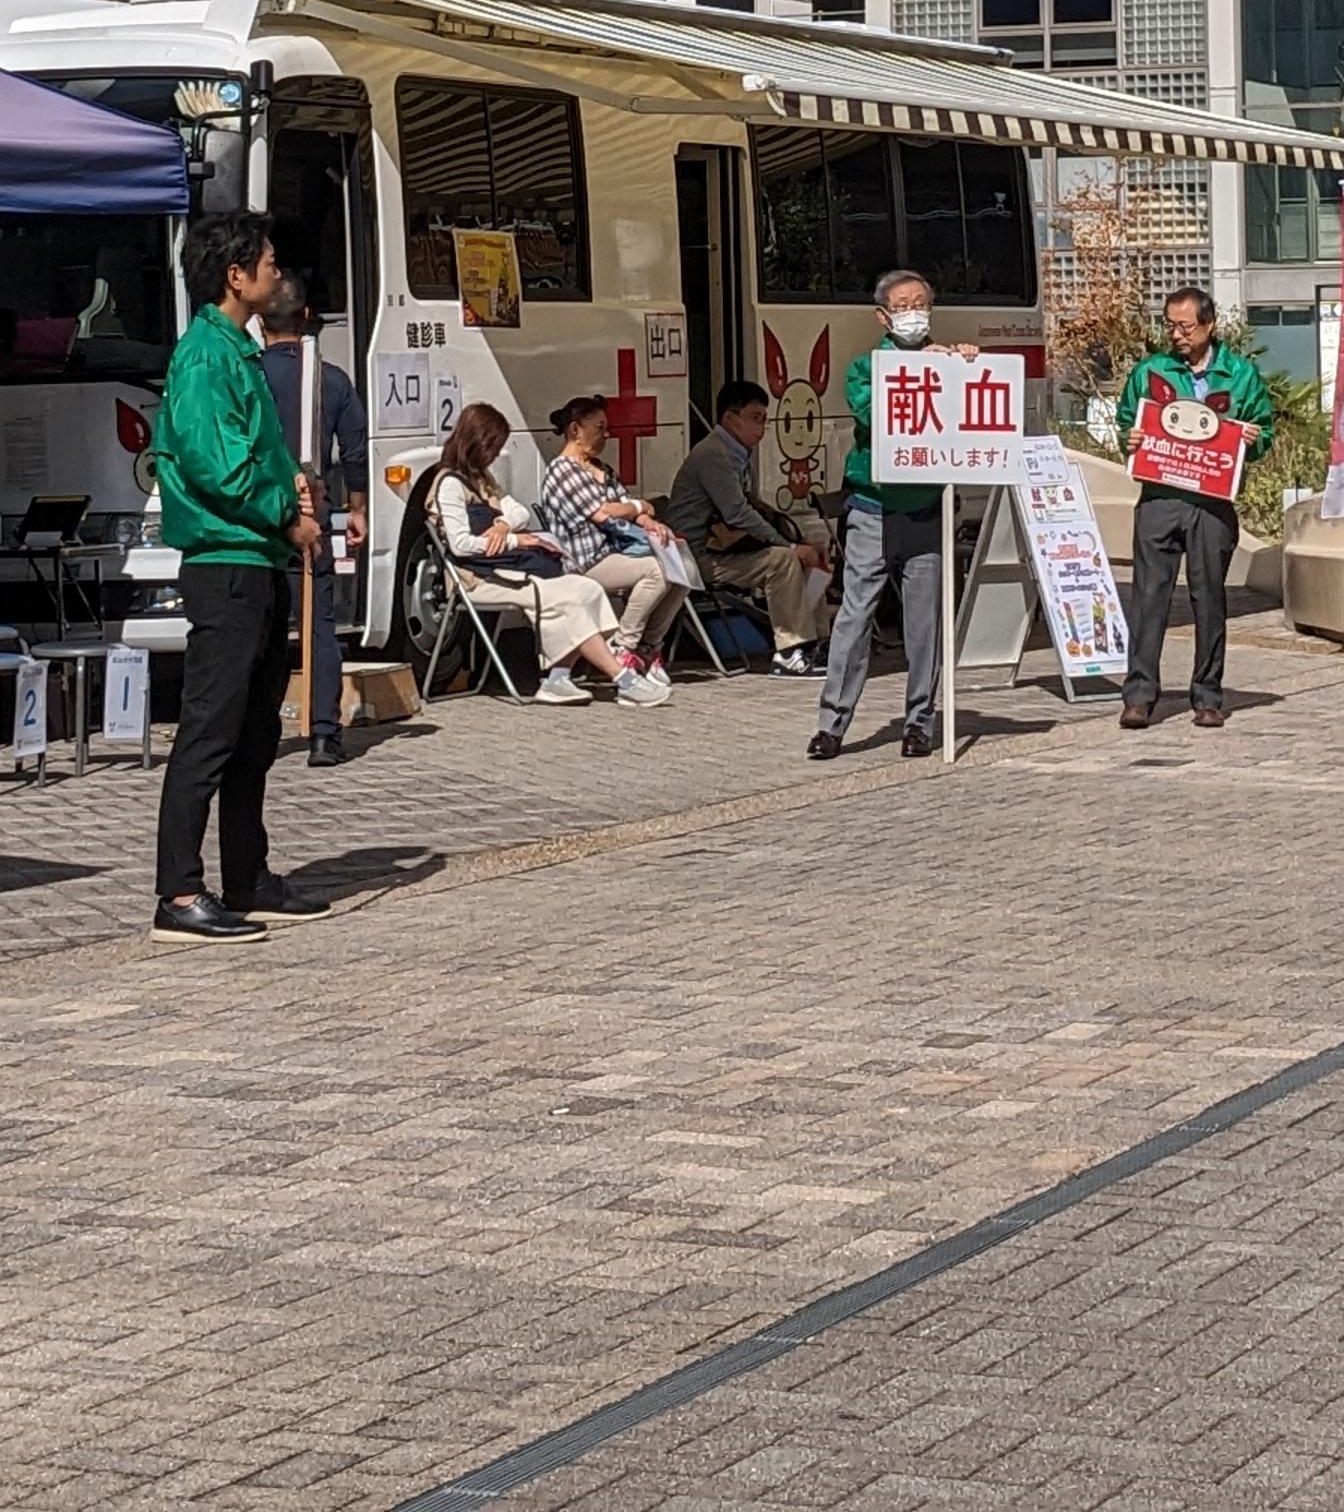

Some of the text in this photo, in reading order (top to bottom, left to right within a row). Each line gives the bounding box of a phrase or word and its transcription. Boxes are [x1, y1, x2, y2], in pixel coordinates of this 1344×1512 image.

[406, 321, 446, 348] 健診車
[651, 325, 681, 359] 出口
[385, 373, 420, 407] 入口
[885, 365, 1017, 436] 献血
[441, 398, 453, 431] 2
[894, 446, 1008, 468] お願いします!
[23, 689, 36, 727] 2
